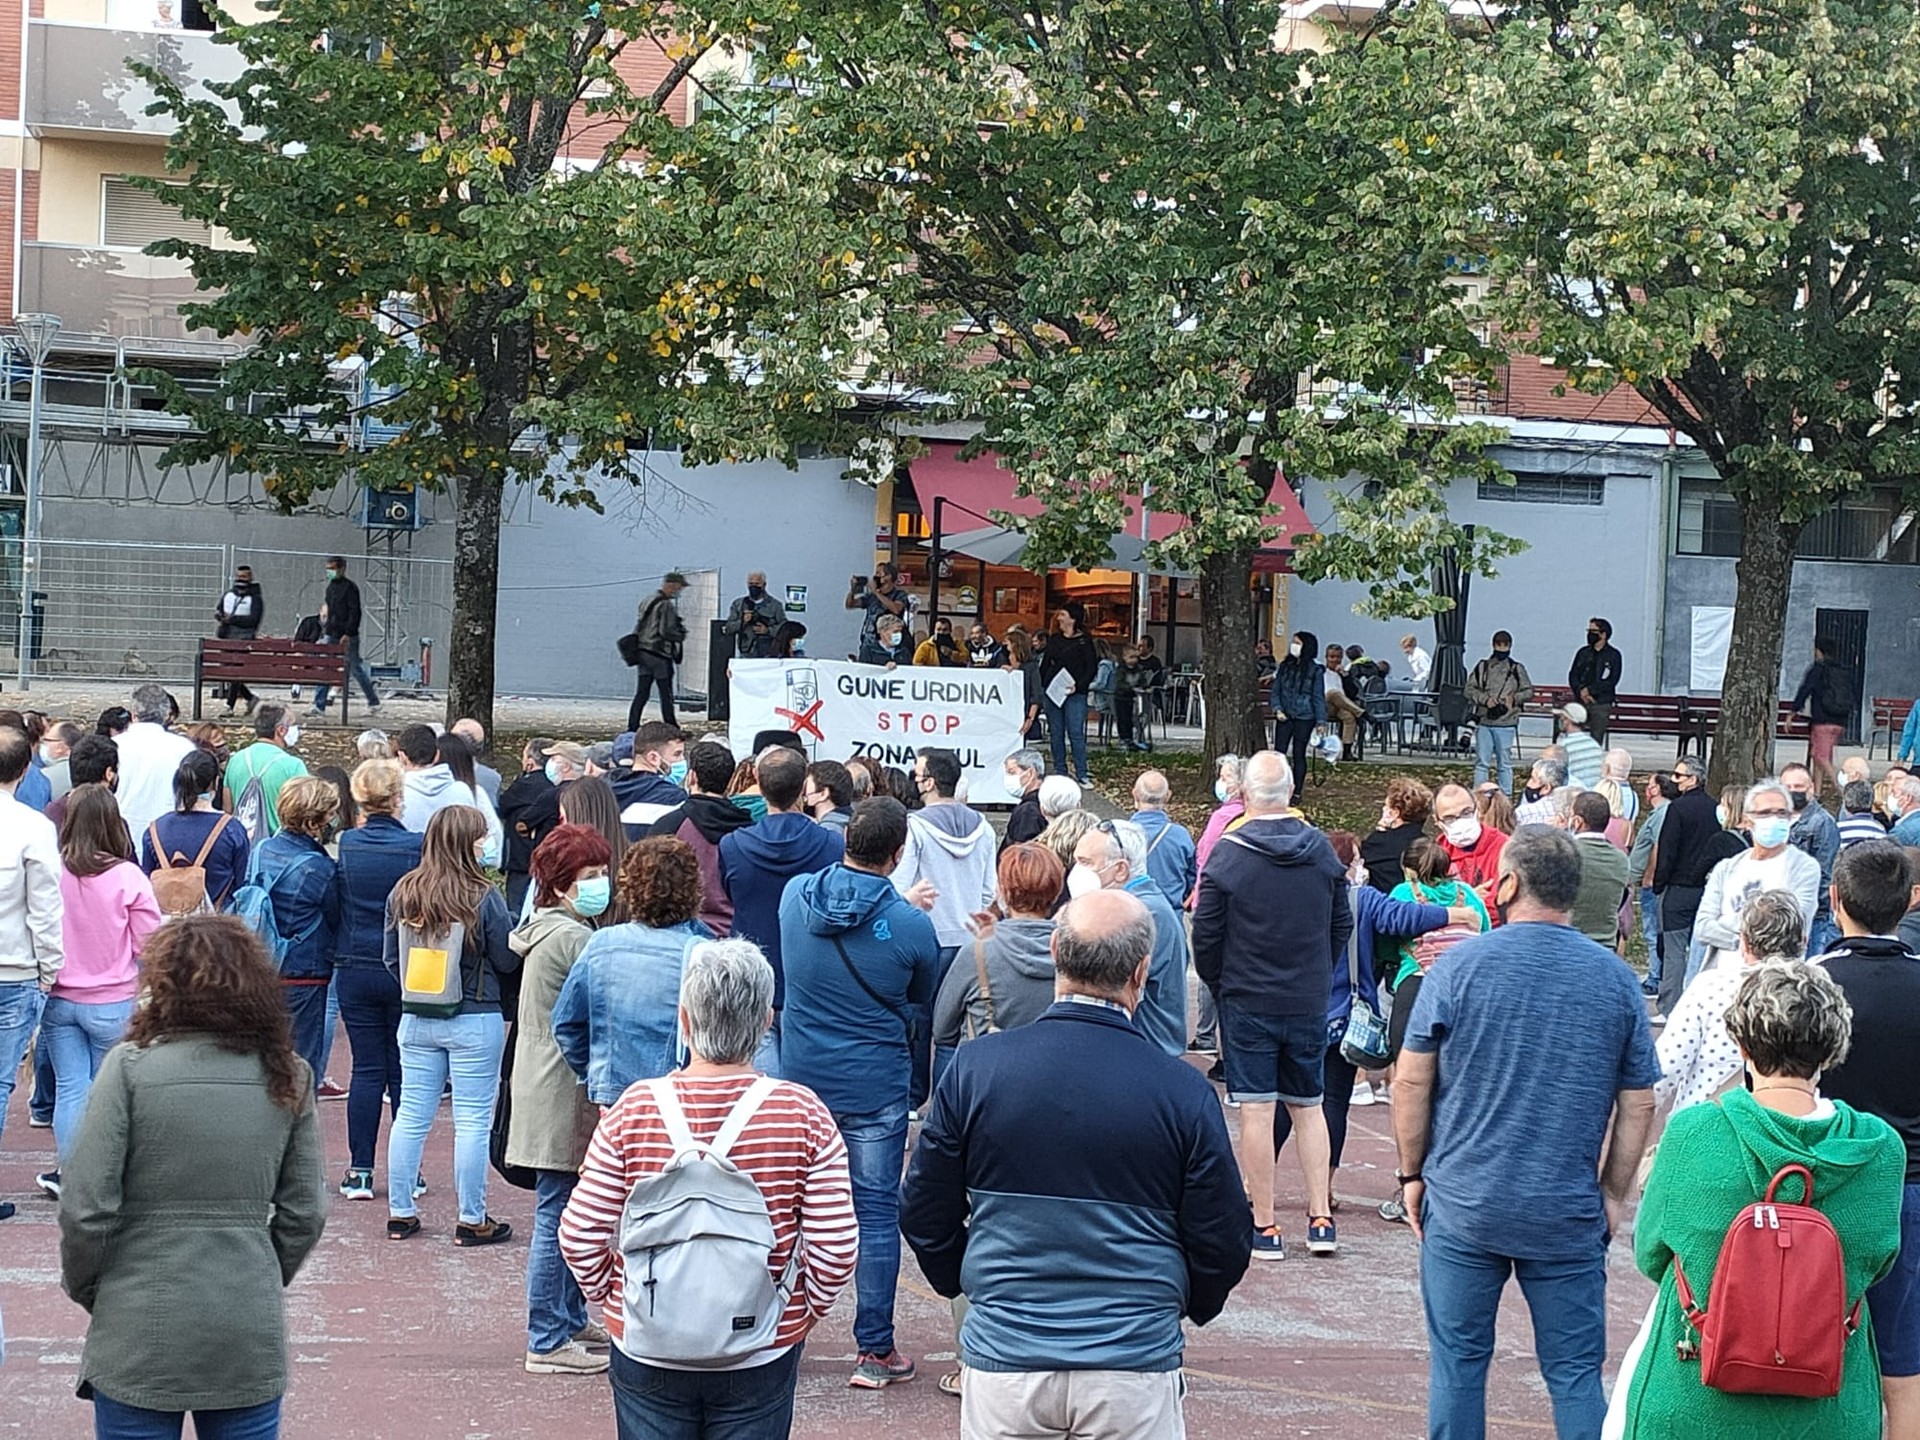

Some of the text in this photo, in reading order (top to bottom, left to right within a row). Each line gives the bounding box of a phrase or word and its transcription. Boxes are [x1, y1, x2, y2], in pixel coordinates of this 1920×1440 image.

[837, 674, 1003, 705] GUNE URDINA
[877, 711, 960, 735] STOP
[850, 741, 917, 765] ZONA
